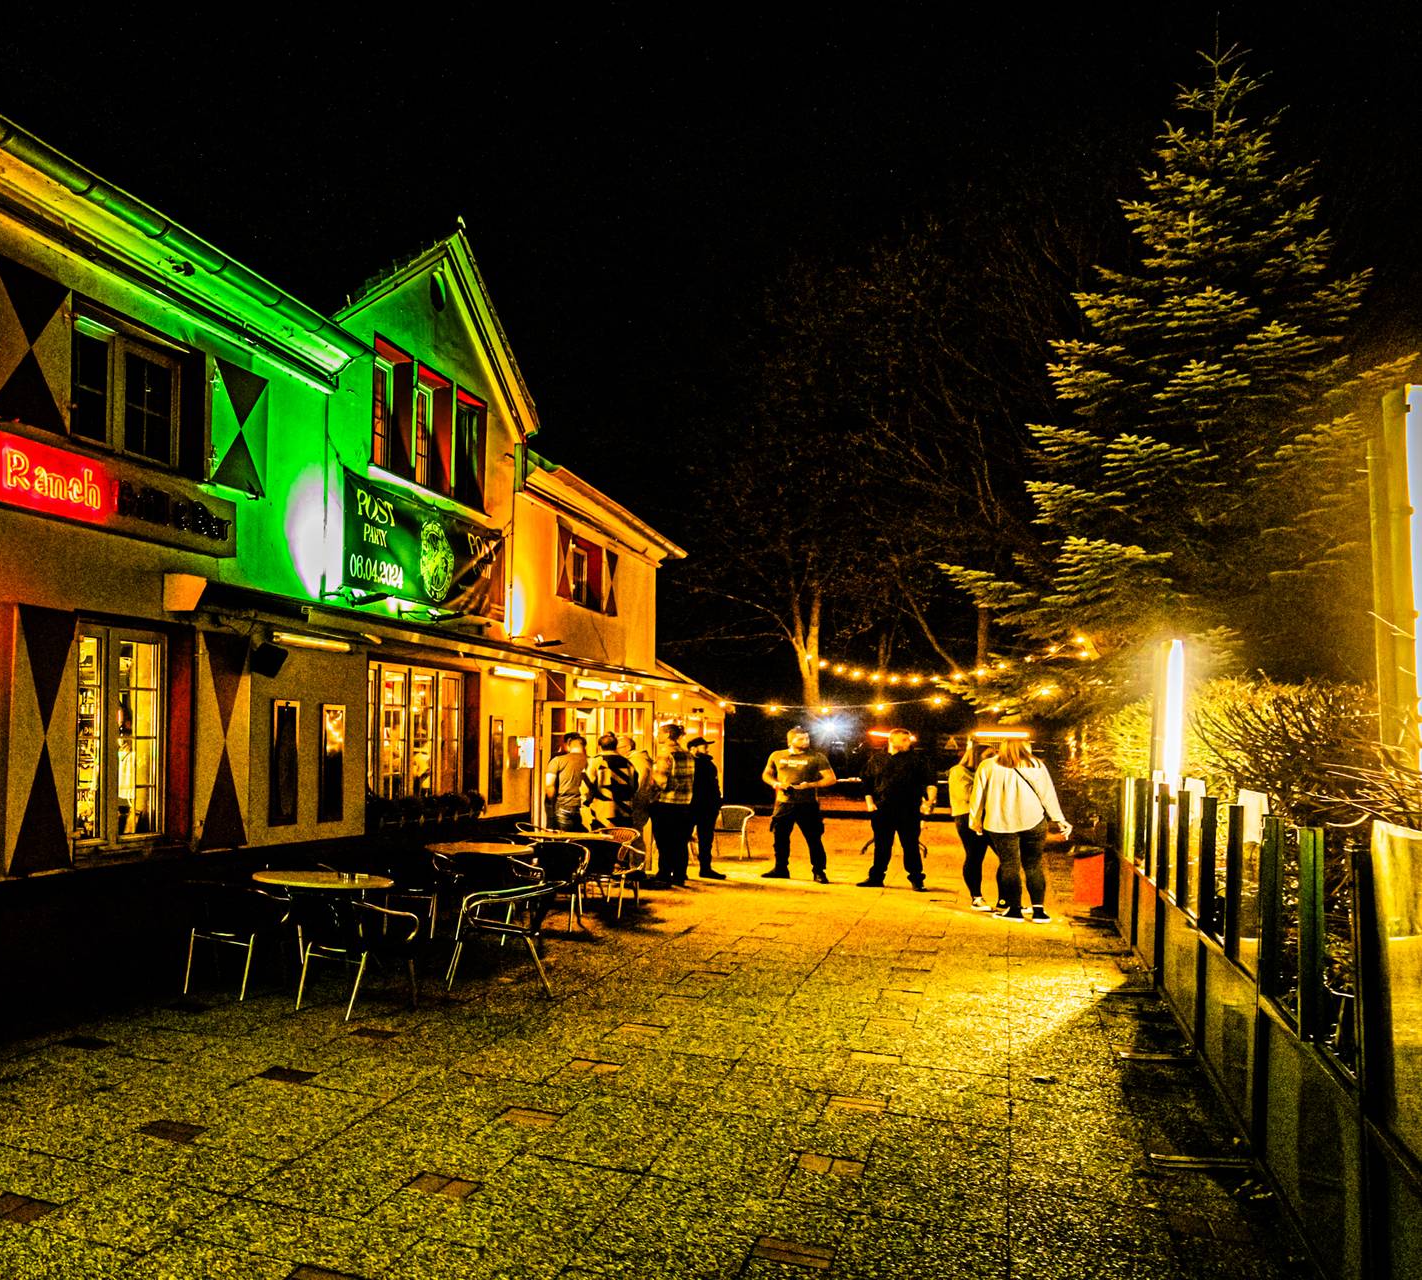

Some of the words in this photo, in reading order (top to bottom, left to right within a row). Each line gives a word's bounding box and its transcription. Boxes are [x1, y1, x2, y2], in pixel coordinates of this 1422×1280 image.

[2, 447, 101, 509] Ranch
[357, 488, 395, 527] POST
[363, 523, 388, 548] PARTY
